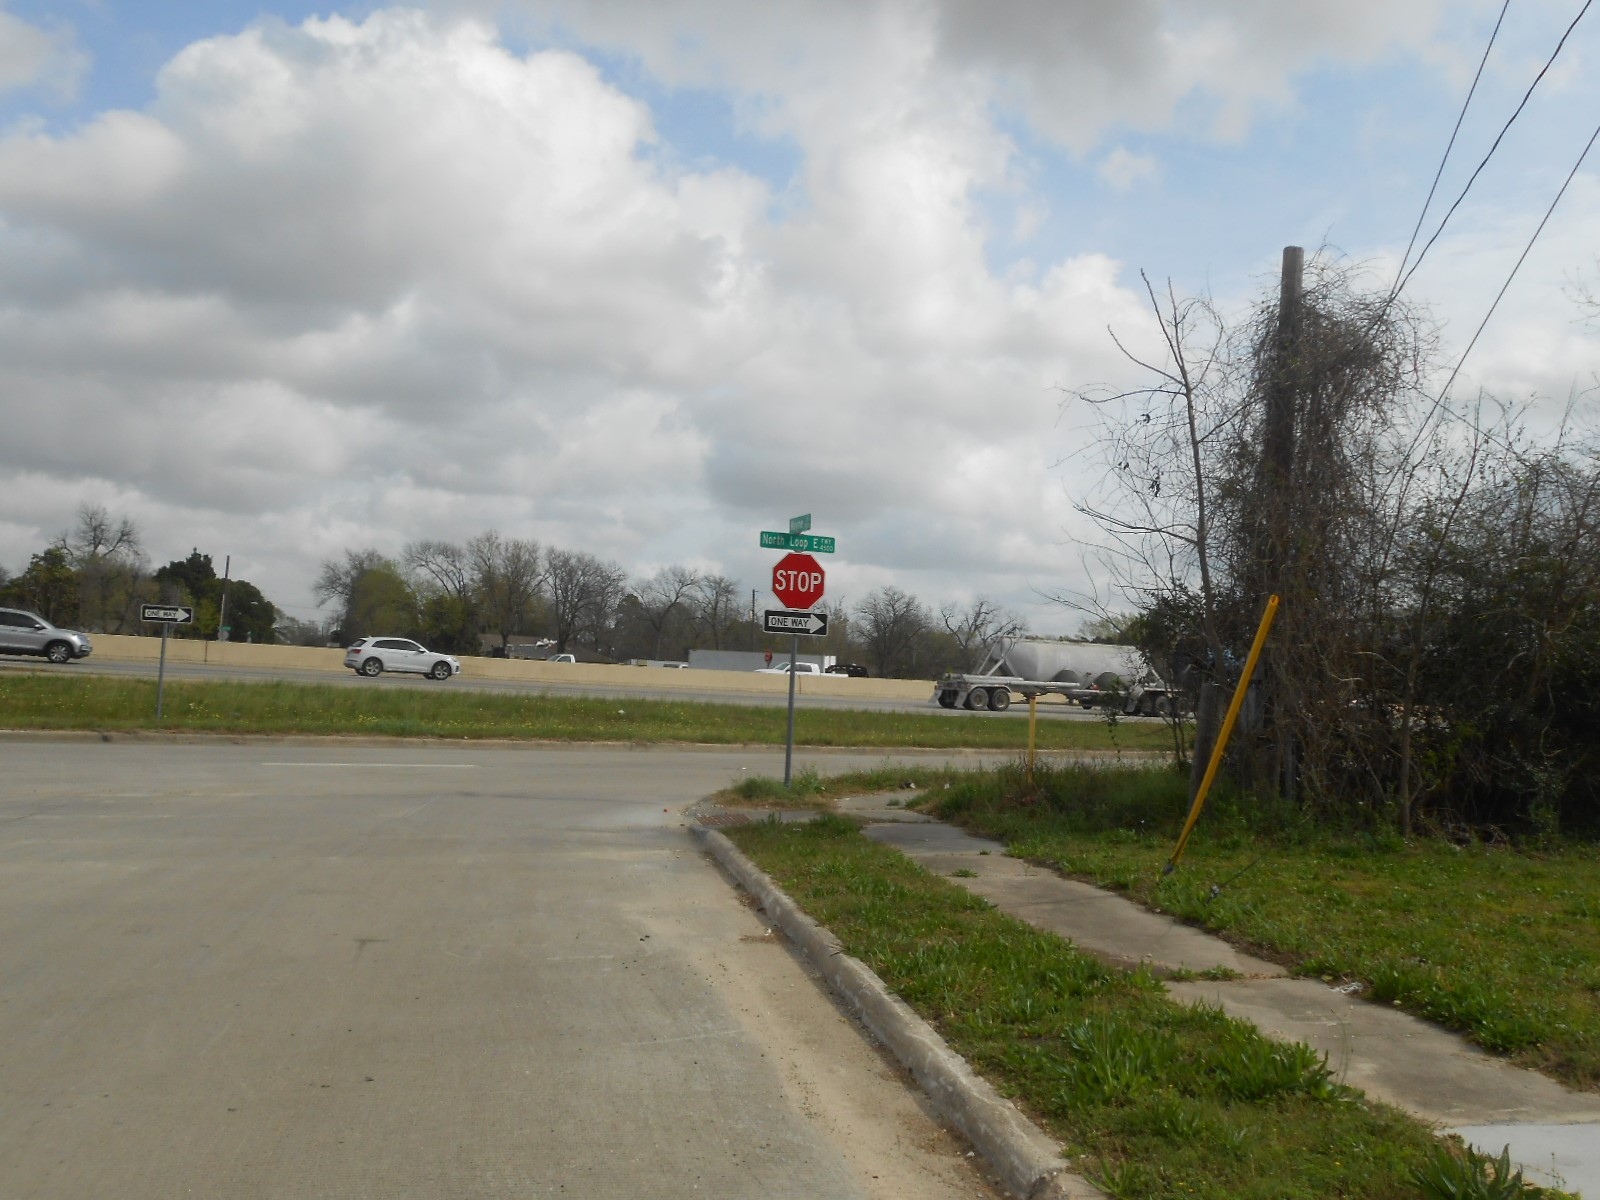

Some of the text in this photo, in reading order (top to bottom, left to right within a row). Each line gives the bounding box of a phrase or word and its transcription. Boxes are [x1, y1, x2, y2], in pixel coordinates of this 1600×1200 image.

[762, 533, 819, 549] North Loop E
[775, 569, 822, 593] STOP
[770, 616, 809, 628] ONE WAY
